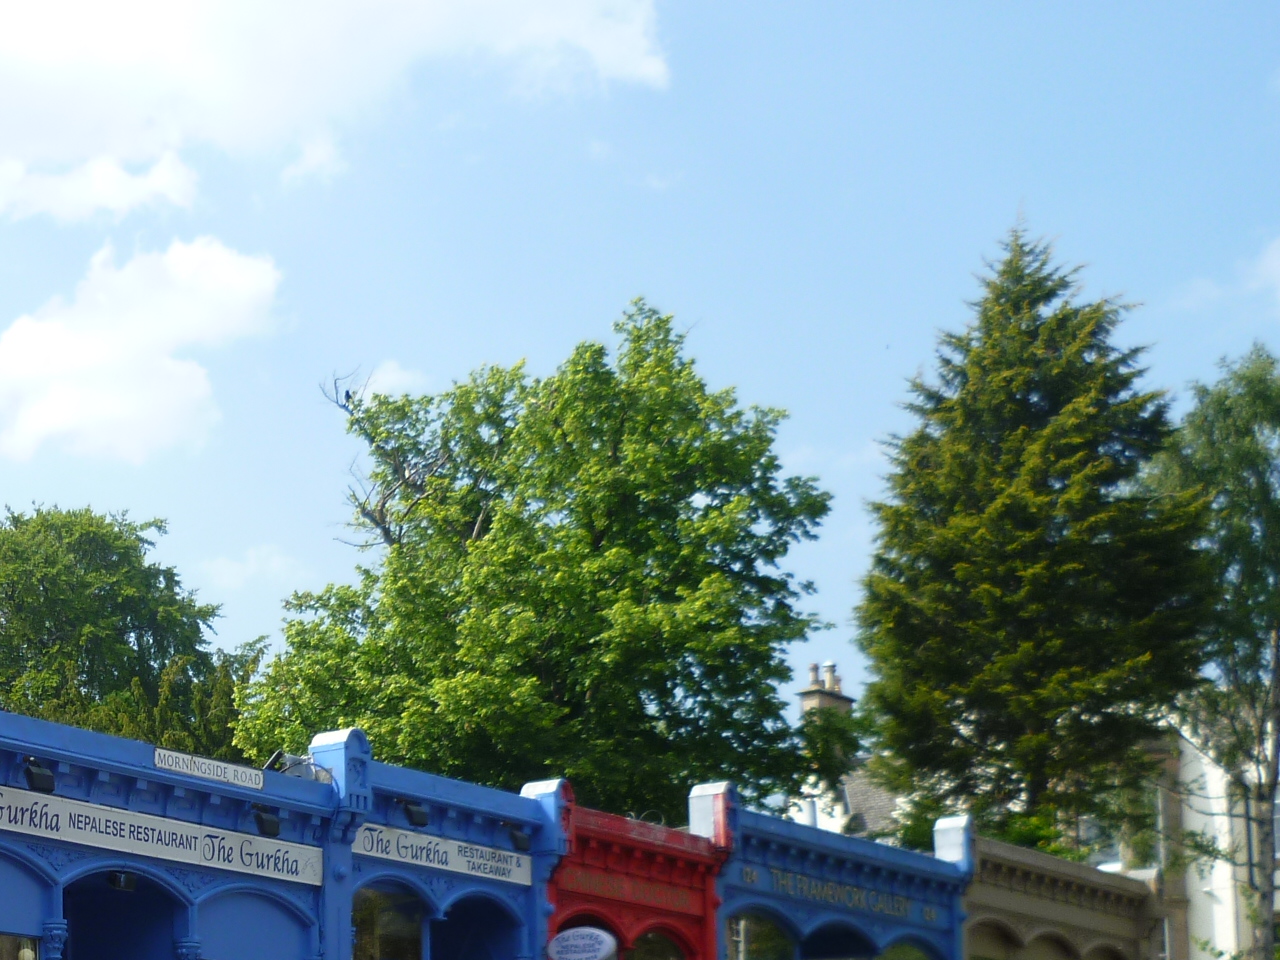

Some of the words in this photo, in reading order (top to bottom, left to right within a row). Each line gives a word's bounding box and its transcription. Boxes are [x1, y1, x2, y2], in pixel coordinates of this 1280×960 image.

[157, 751, 228, 779] MORNINGSIDE
[233, 768, 261, 786] ROAD
[68, 811, 126, 838] NEPALESE
[128, 823, 199, 852] RESTAURANT
[202, 834, 234, 863] The
[240, 839, 300, 877] Gurkha
[362, 827, 391, 855] The
[396, 833, 449, 867] Gurkha
[457, 845, 514, 866] RESTAURANT
[515, 857, 522, 868] &
[466, 860, 512, 878] TAKEAWAY
[564, 867, 626, 898] CHINESE
[770, 868, 795, 895] THE
